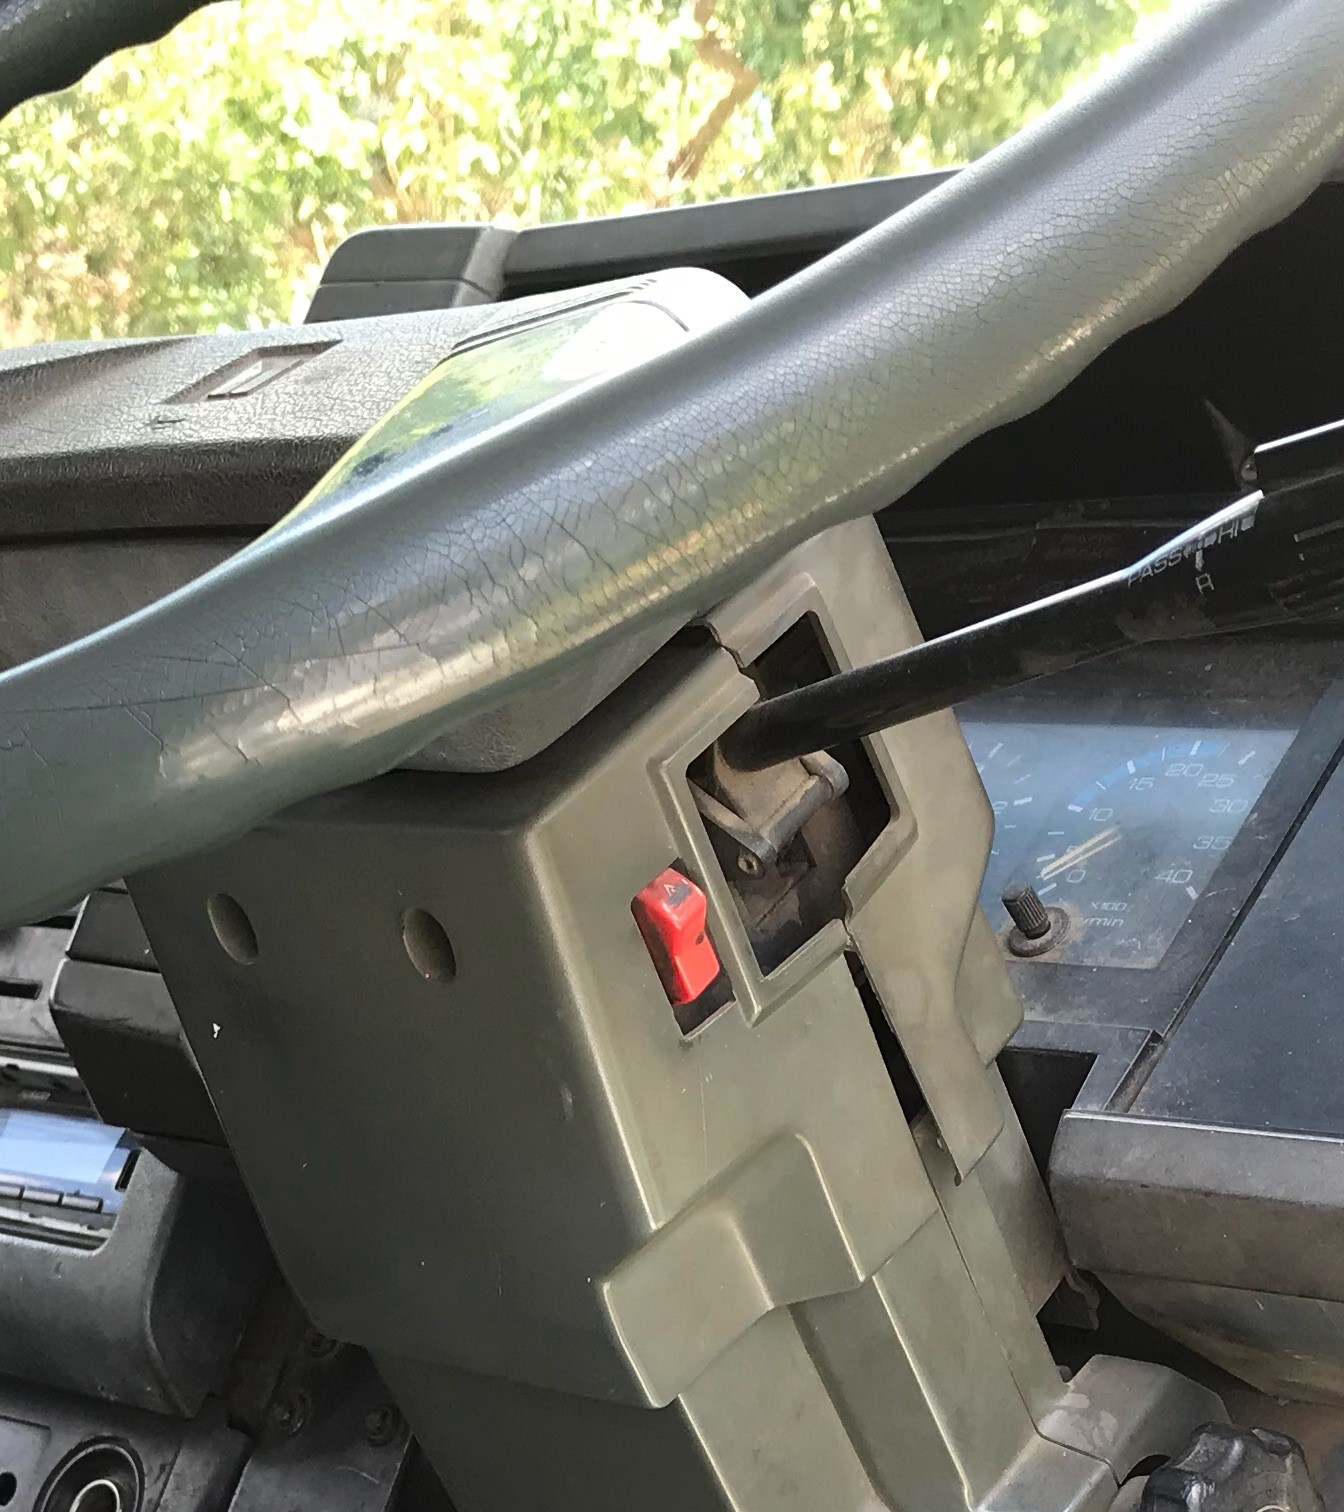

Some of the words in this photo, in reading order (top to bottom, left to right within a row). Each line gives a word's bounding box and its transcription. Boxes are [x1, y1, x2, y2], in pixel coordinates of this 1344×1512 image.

[1164, 763, 1204, 777] 20
[1129, 777, 1155, 791] 15
[1197, 773, 1234, 788] 25
[1208, 799, 1249, 813] 30
[1087, 808, 1113, 822] 10
[1192, 836, 1234, 850] 35
[1066, 869, 1086, 884] 0
[1155, 869, 1194, 884] 40
